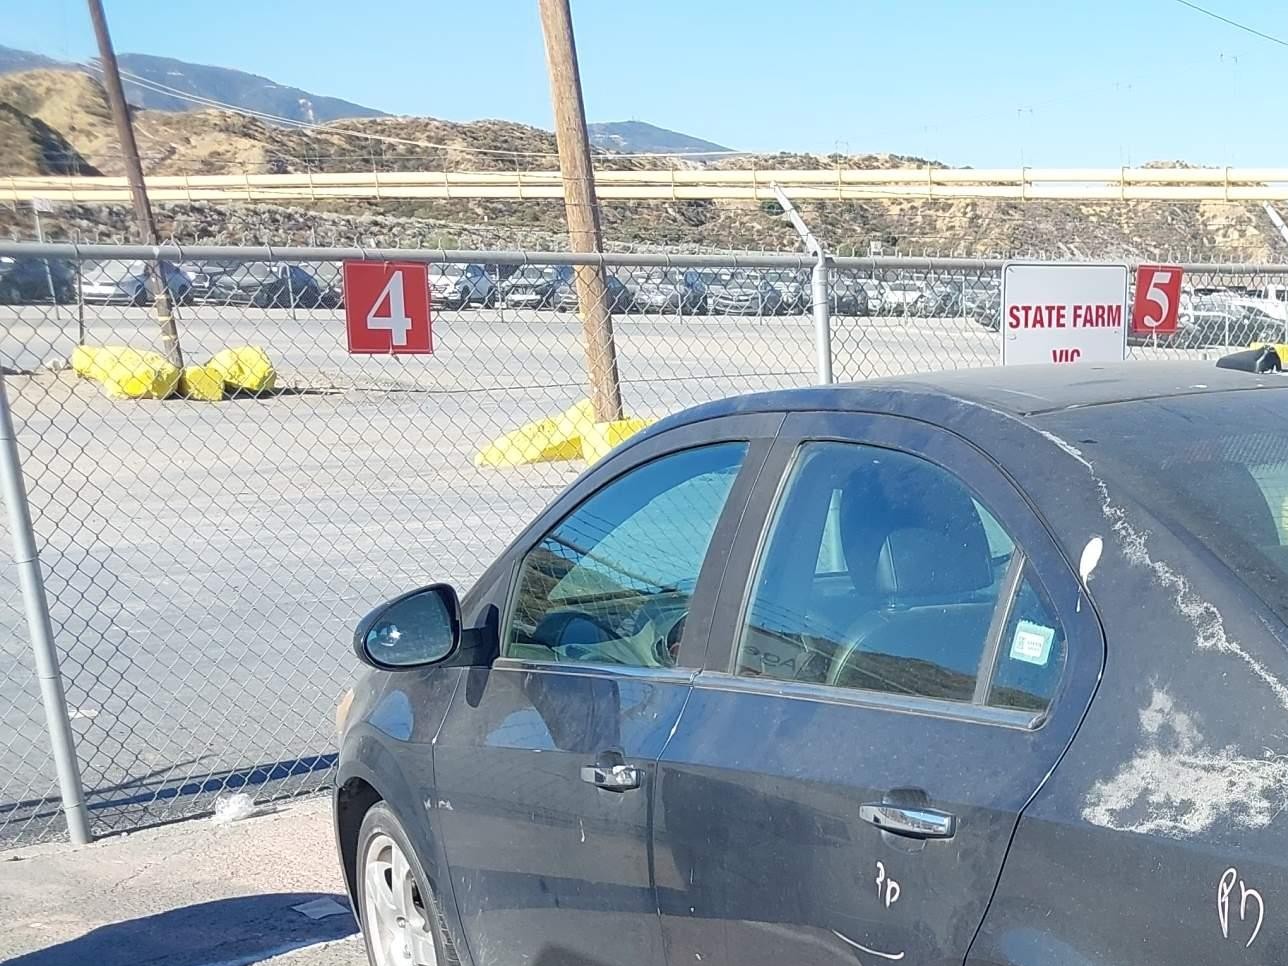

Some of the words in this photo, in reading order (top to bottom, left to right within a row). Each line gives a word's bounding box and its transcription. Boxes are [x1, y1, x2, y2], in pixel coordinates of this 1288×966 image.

[366, 270, 413, 346] 4
[1008, 305, 1066, 329] STATE
[1073, 305, 1121, 328] FARM
[1143, 271, 1172, 327] 5
